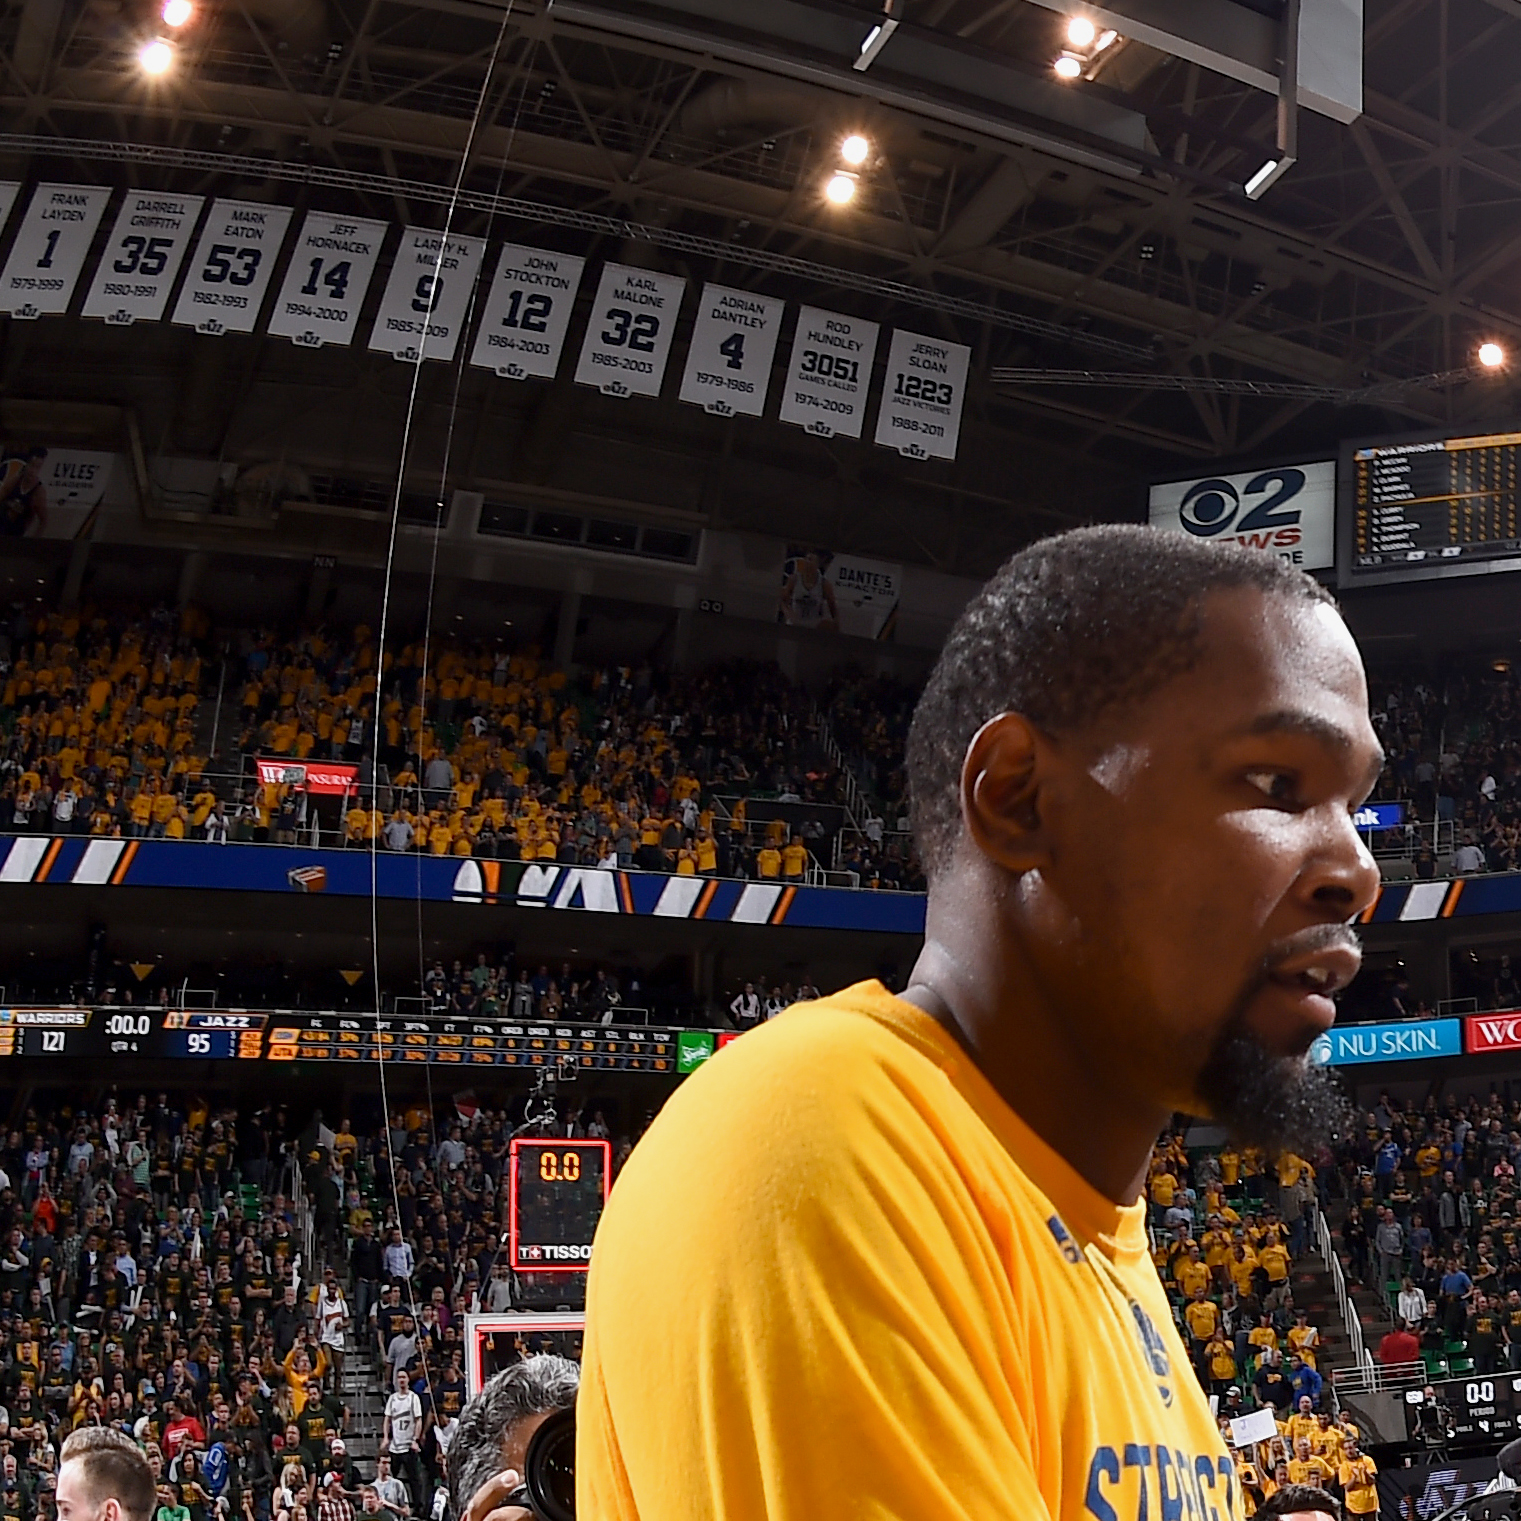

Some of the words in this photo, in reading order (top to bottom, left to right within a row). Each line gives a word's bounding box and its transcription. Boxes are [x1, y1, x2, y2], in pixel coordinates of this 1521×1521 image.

[50, 192, 90, 207] FRANK
[135, 200, 186, 215] DARRELL
[41, 208, 86, 222] LAYDEN
[130, 215, 181, 230] GRIFFITH
[231, 210, 267, 225] MARK
[223, 226, 265, 240] EATON
[329, 225, 358, 237] JEFF
[37, 230, 61, 268] 1
[113, 235, 174, 276] 35
[306, 237, 371, 255] HORNACEK
[202, 243, 262, 286] 53
[523, 256, 559, 273] JOHN
[10, 276, 64, 291] 1979-1999
[301, 257, 352, 300] 14
[504, 268, 570, 290] STOCKTON
[626, 276, 659, 292] KARL
[103, 283, 157, 298] 1980-1991
[193, 291, 248, 309] 1982-1993
[411, 274, 444, 313] 9
[612, 289, 665, 308] MALONE
[285, 302, 348, 322] 1994-2000
[502, 290, 553, 333] 12
[719, 296, 765, 314] ADRIAN
[711, 308, 767, 329] DANTLEY
[826, 320, 851, 335] ROD
[601, 308, 660, 352] 32
[488, 334, 551, 355] 1984-2003
[719, 332, 745, 370] 4
[807, 331, 863, 352] HUNDLEY
[912, 343, 948, 359] JERRY
[591, 352, 653, 374] 1985-2003
[801, 350, 859, 384] 3051
[908, 356, 947, 374] SLOAN
[696, 372, 754, 393] 1979-1986
[894, 373, 953, 405] 1223
[795, 392, 854, 415] 1974-2009
[891, 416, 944, 437] 1988-2011
[1235, 468, 1306, 532] 2
[839, 567, 892, 588] DANTE'S
[16, 1013, 85, 1025] WARRIORS
[105, 1015, 150, 1035] :00.0
[199, 1016, 250, 1028] JAZZ
[42, 1031, 65, 1051] 121
[130, 1041, 138, 1052] 4
[188, 1033, 211, 1053] 95
[1339, 1033, 1377, 1057] NU
[541, 1152, 580, 1181] 0.0
[542, 1245, 594, 1259] TISSO
[399, 1418, 410, 1431] 17
